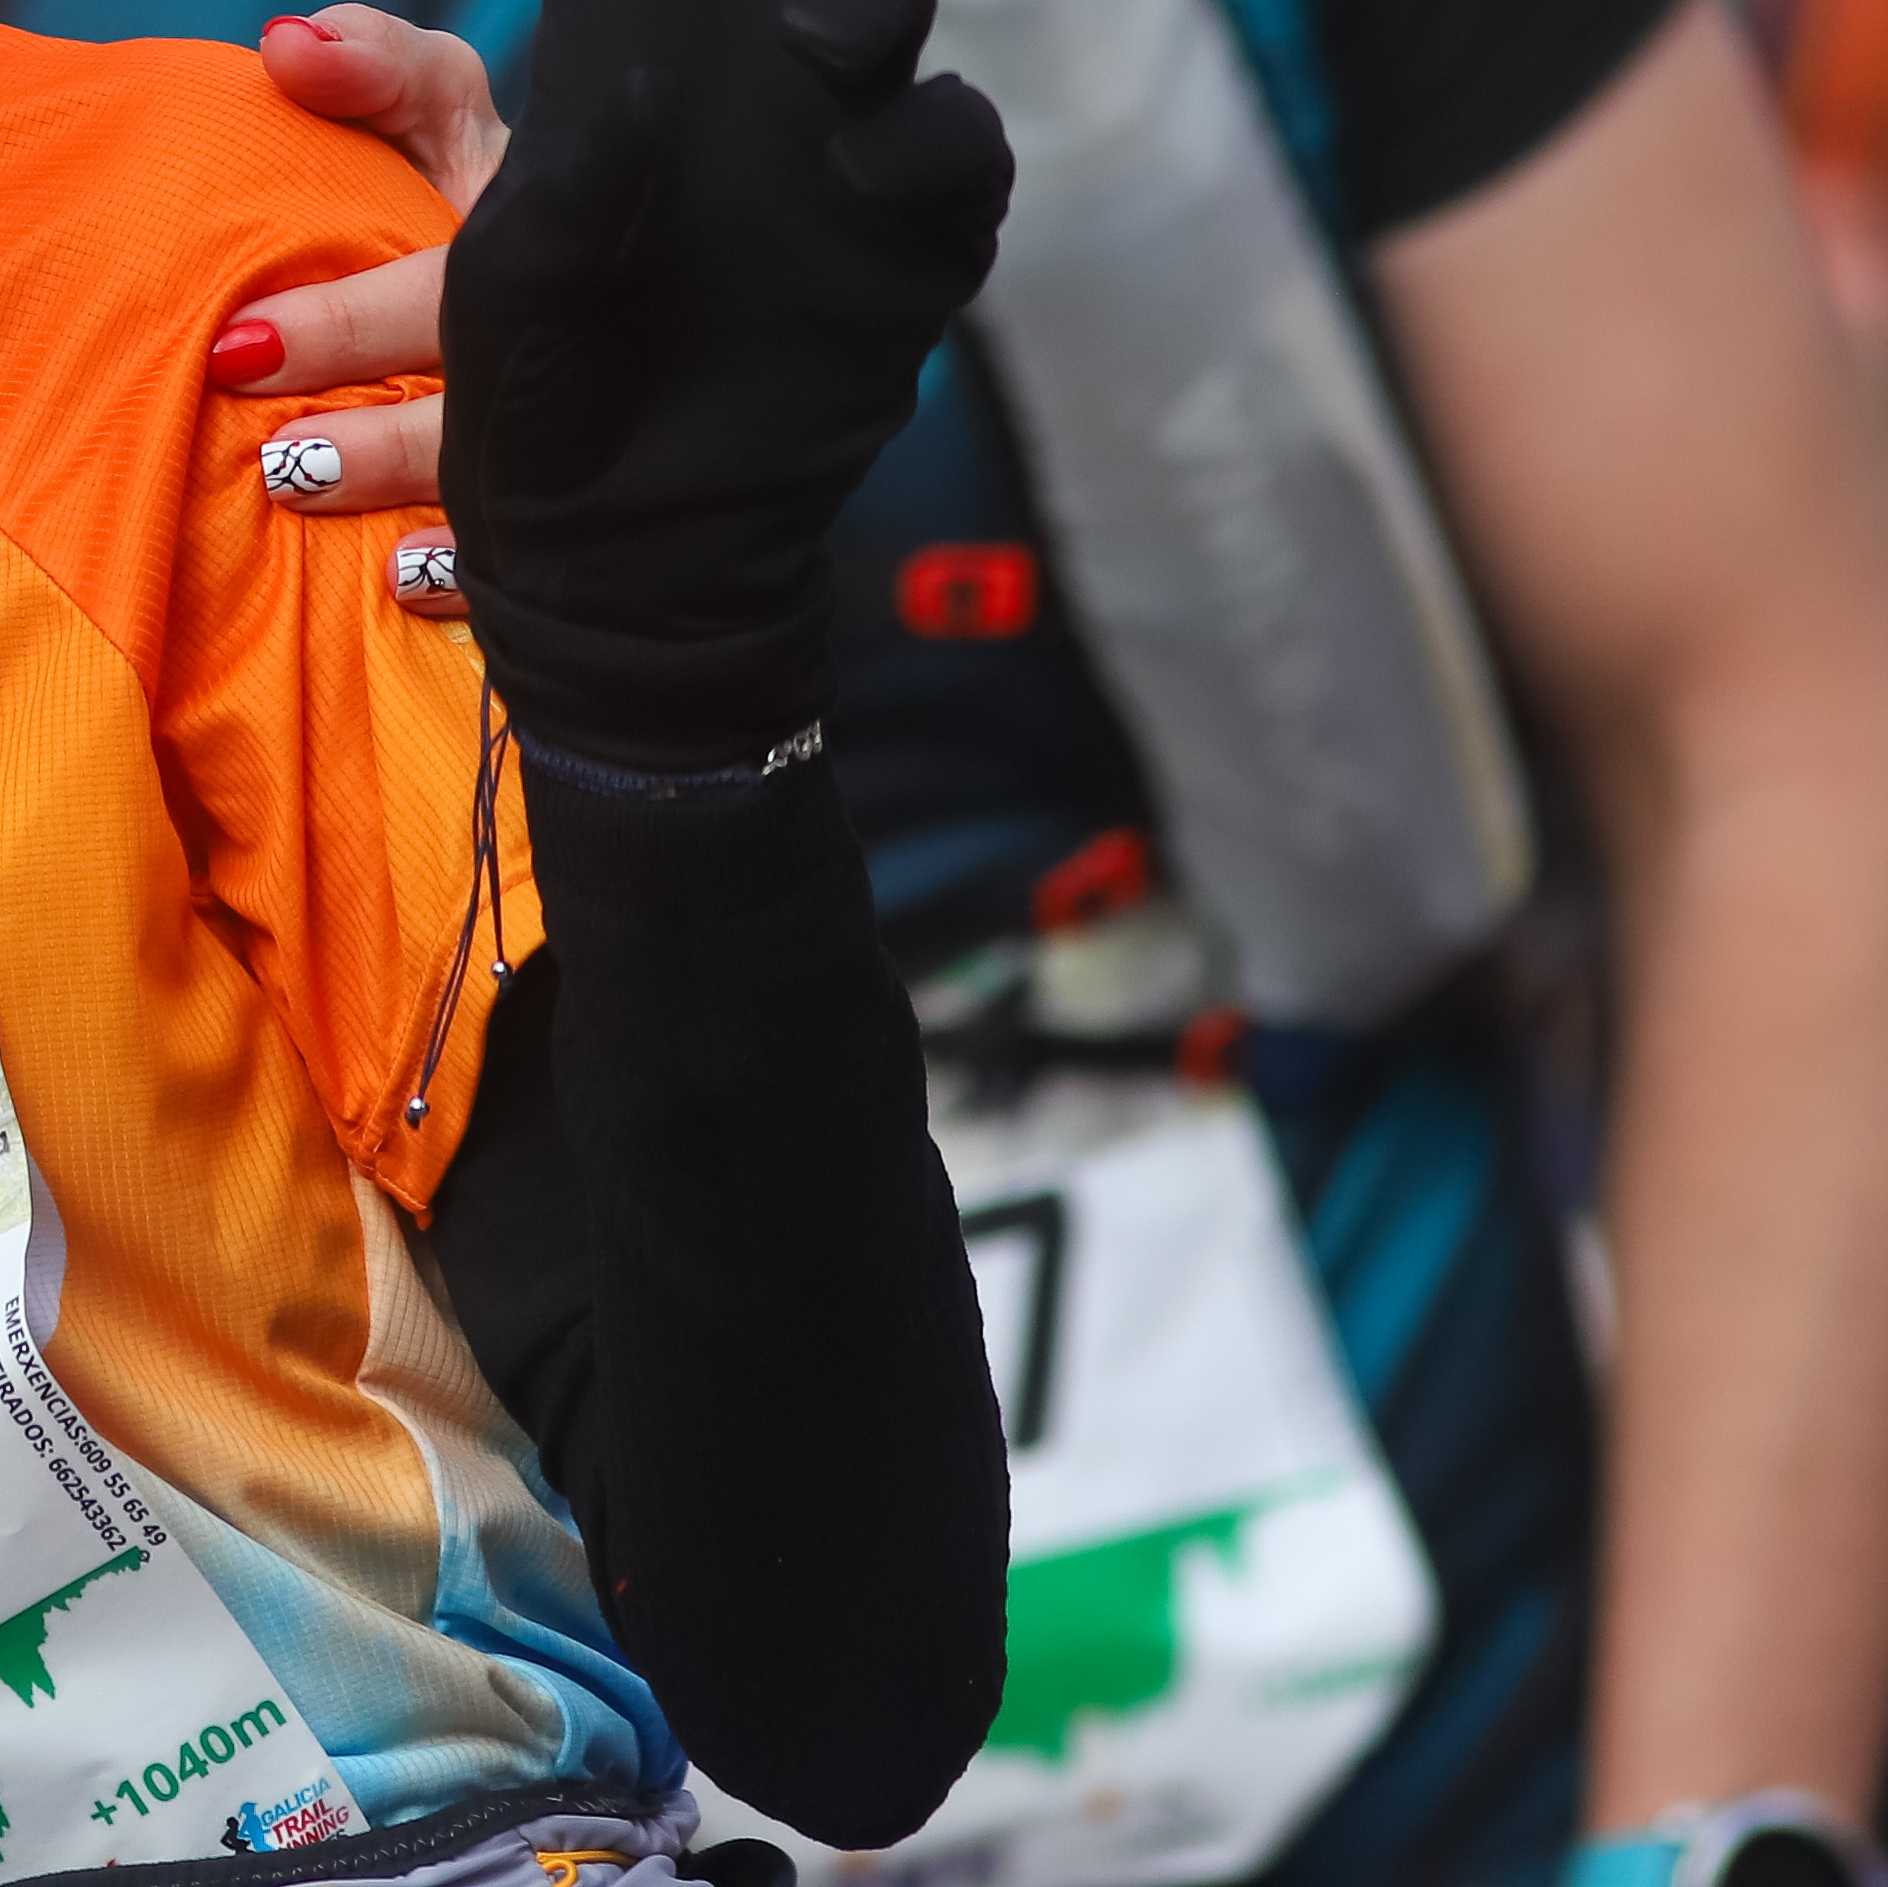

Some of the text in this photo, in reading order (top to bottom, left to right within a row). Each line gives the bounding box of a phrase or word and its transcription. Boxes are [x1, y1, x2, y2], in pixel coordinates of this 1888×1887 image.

[48, 1457, 127, 1552] 662543362
[103, 1472, 131, 1499] 55
[123, 1498, 150, 1524] 65
[143, 1524, 168, 1547] 49
[90, 1699, 288, 1826] +1040m
[261, 1777, 331, 1826] GALICIA
[272, 1798, 334, 1844] TRAIL
